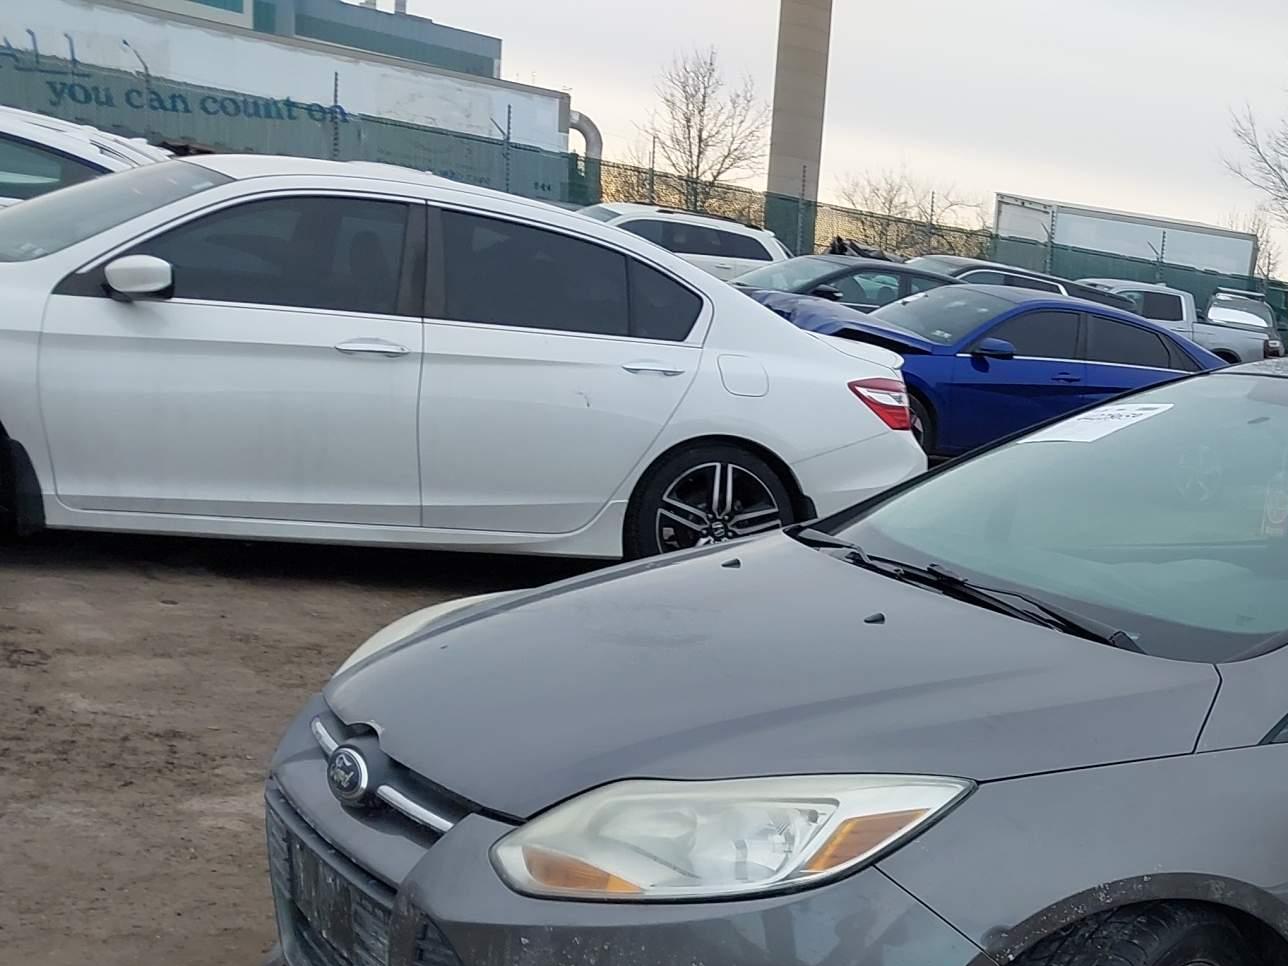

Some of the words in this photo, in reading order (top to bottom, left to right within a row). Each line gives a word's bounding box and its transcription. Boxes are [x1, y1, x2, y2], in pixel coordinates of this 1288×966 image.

[46, 80, 116, 107] you
[125, 87, 192, 113] can
[201, 95, 297, 120] count
[307, 103, 349, 123] on
